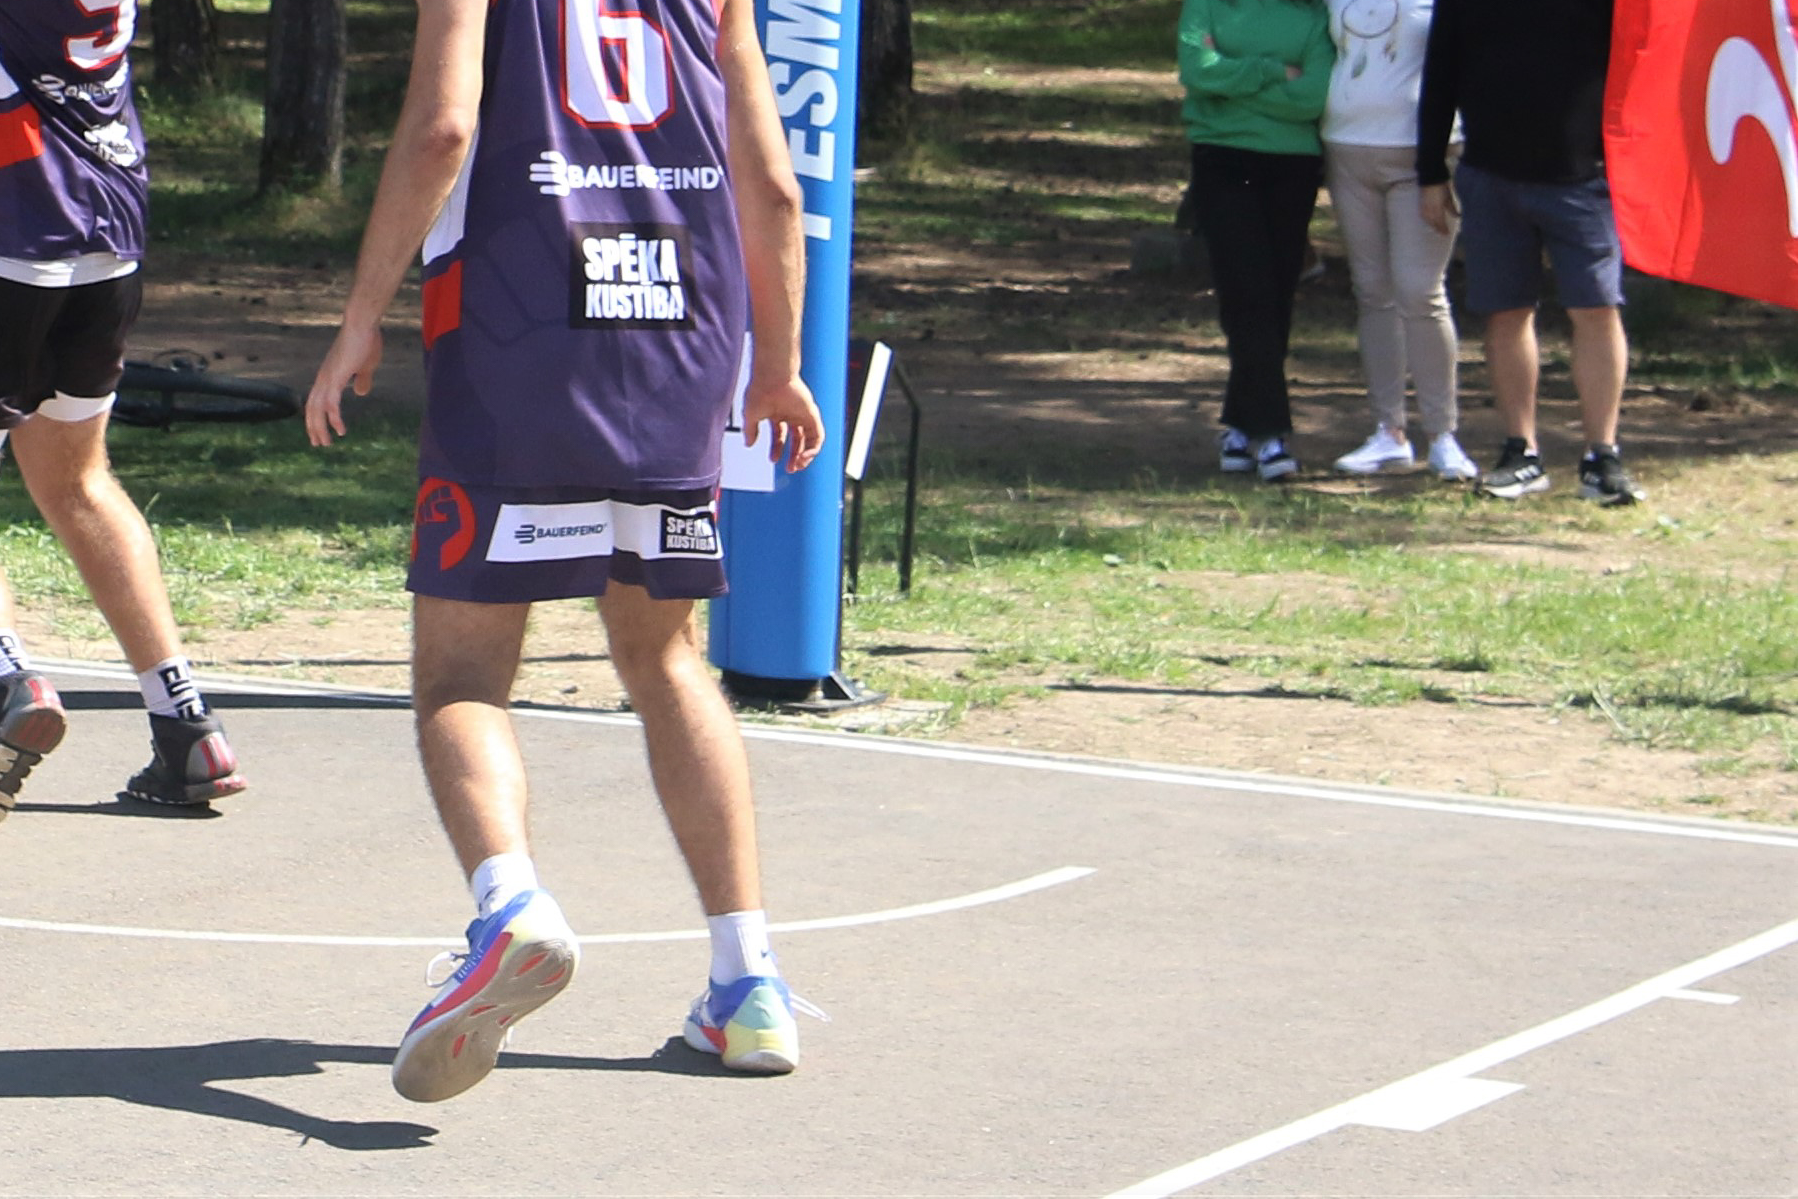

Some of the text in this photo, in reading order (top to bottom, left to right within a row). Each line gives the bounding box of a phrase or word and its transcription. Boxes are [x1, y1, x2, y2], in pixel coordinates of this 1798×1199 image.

[582, 232, 681, 283] SPĒKA
[585, 280, 686, 320] KUSTĪBA
[536, 523, 604, 538] BAUERFEIND
